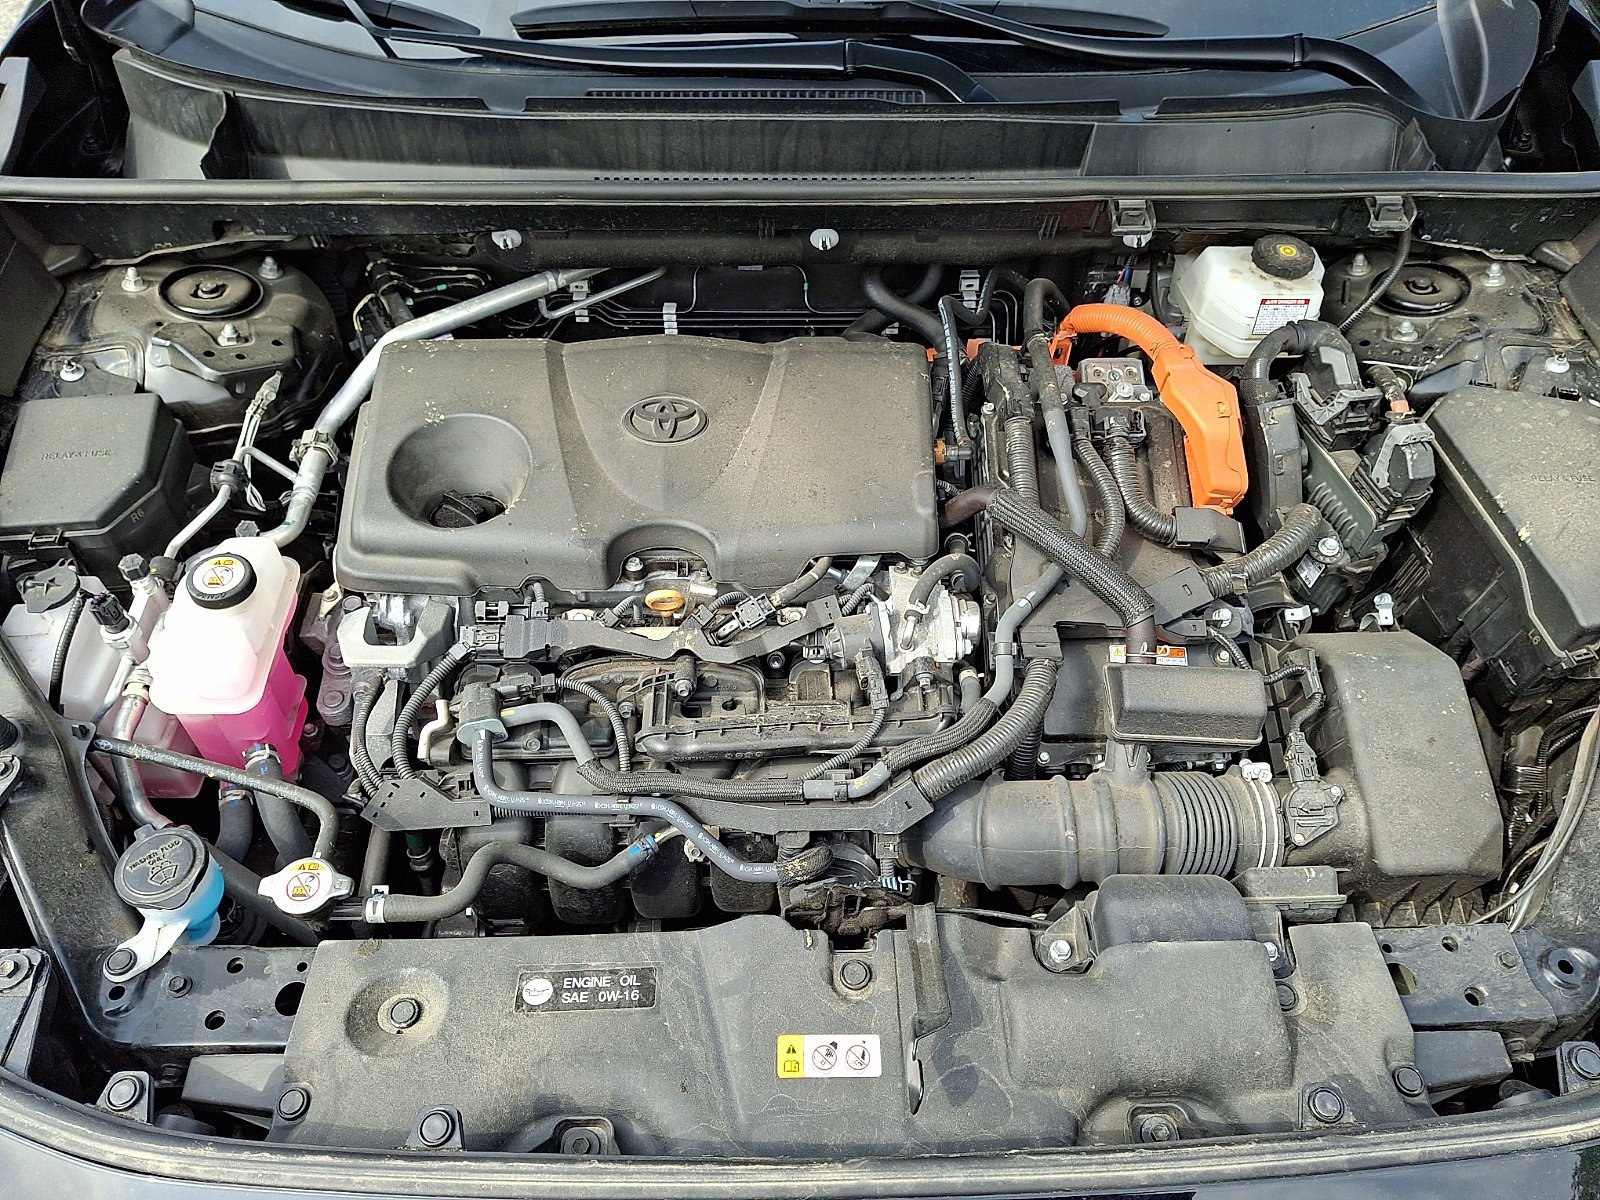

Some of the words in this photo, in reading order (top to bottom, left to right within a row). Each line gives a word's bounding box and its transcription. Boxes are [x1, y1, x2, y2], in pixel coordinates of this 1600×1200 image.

[41, 451, 75, 460] RELAY
[84, 448, 113, 458] FUSE
[1530, 474, 1561, 482] RELAY
[1570, 474, 1596, 483] FUSE
[130, 508, 145, 524] R6
[1528, 628, 1541, 645] L6
[160, 840, 180, 853] FLUID
[563, 976, 612, 989] ENGINE
[619, 974, 641, 987] OIL
[561, 991, 590, 1004] SAE
[598, 989, 641, 1003] 0W-16
